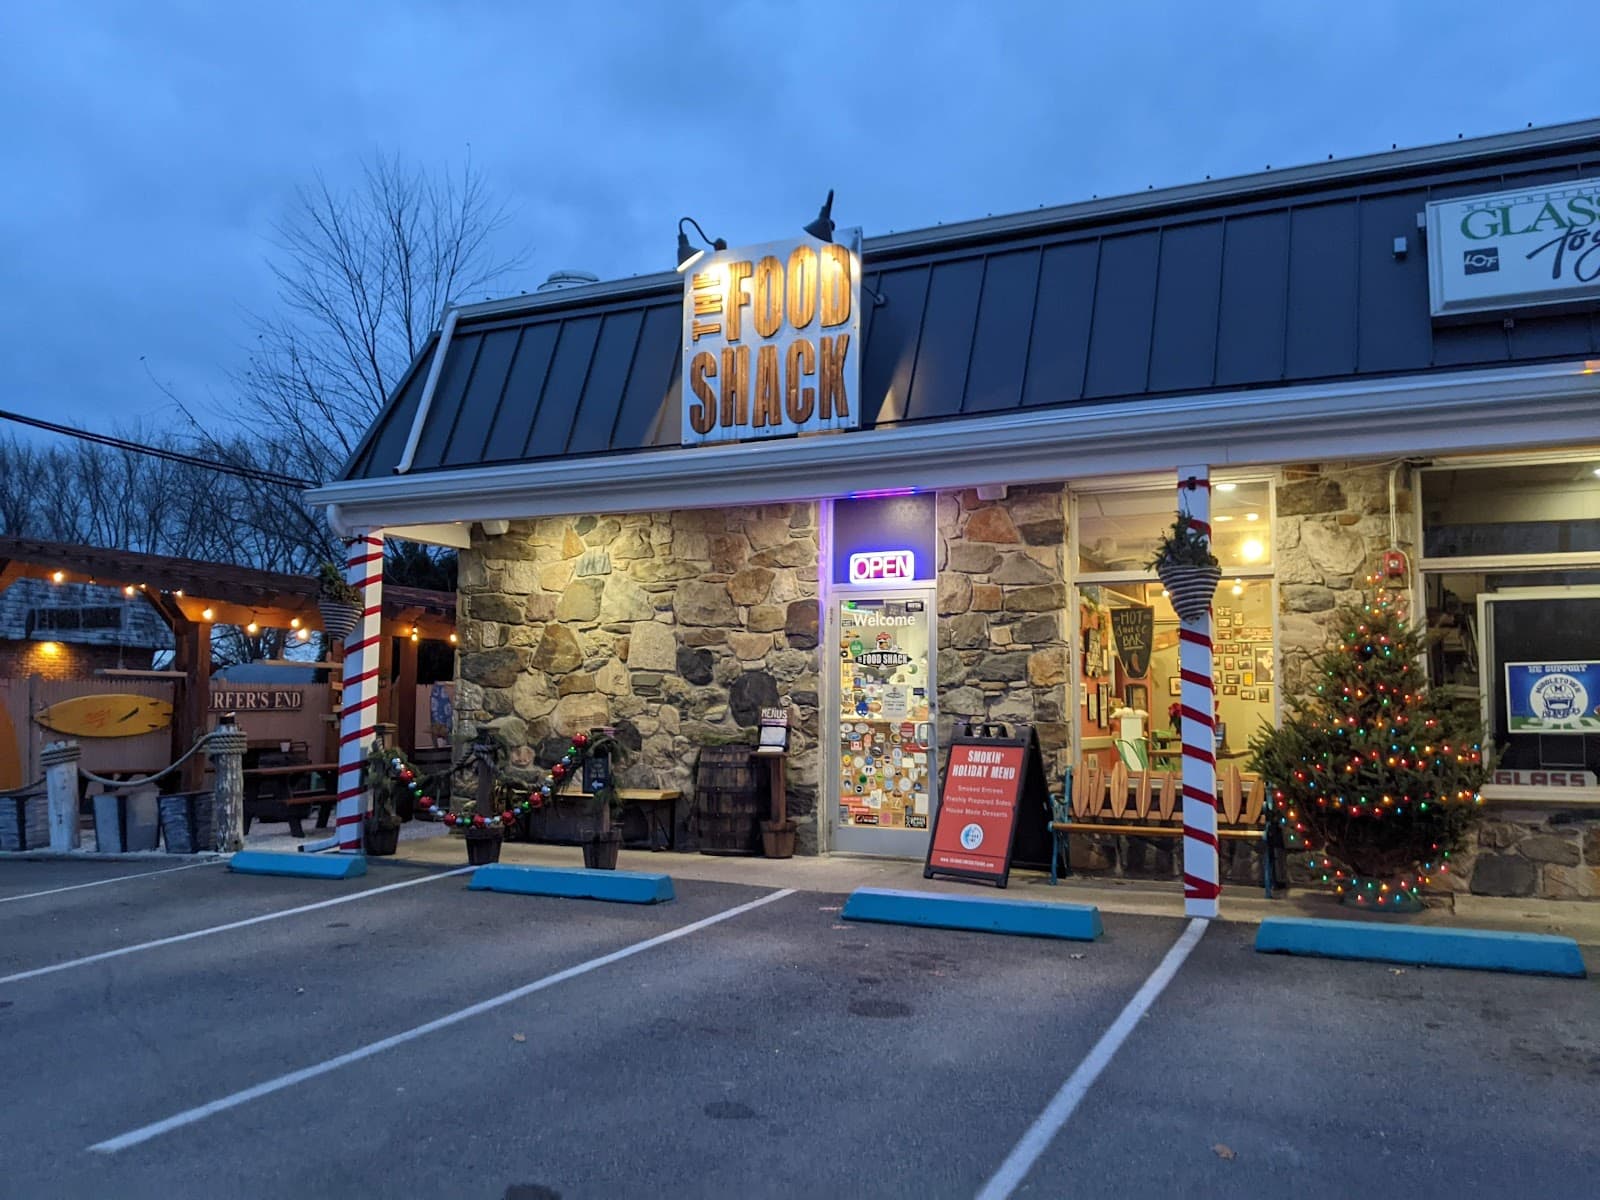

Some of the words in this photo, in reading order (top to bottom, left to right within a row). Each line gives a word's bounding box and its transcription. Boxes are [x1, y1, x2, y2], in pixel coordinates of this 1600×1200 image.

[1461, 195, 1600, 240] GLAS
[726, 243, 852, 342] FOOD
[692, 272, 722, 342] THE
[690, 333, 850, 434] SHACK
[853, 555, 910, 580] OPEN
[852, 612, 917, 626] Welcome
[1120, 611, 1144, 625] HOT
[1122, 634, 1145, 648] BAR
[863, 654, 881, 665] FOOD
[883, 653, 908, 664] SHACK
[1544, 664, 1588, 673] SUPPORT
[274, 691, 301, 709] END
[761, 707, 788, 719] MENUS
[967, 750, 1005, 765] SMOKIN'
[952, 764, 989, 778] HOLIDAY
[990, 766, 1016, 780] MENU
[1495, 771, 1586, 787] GLASS
